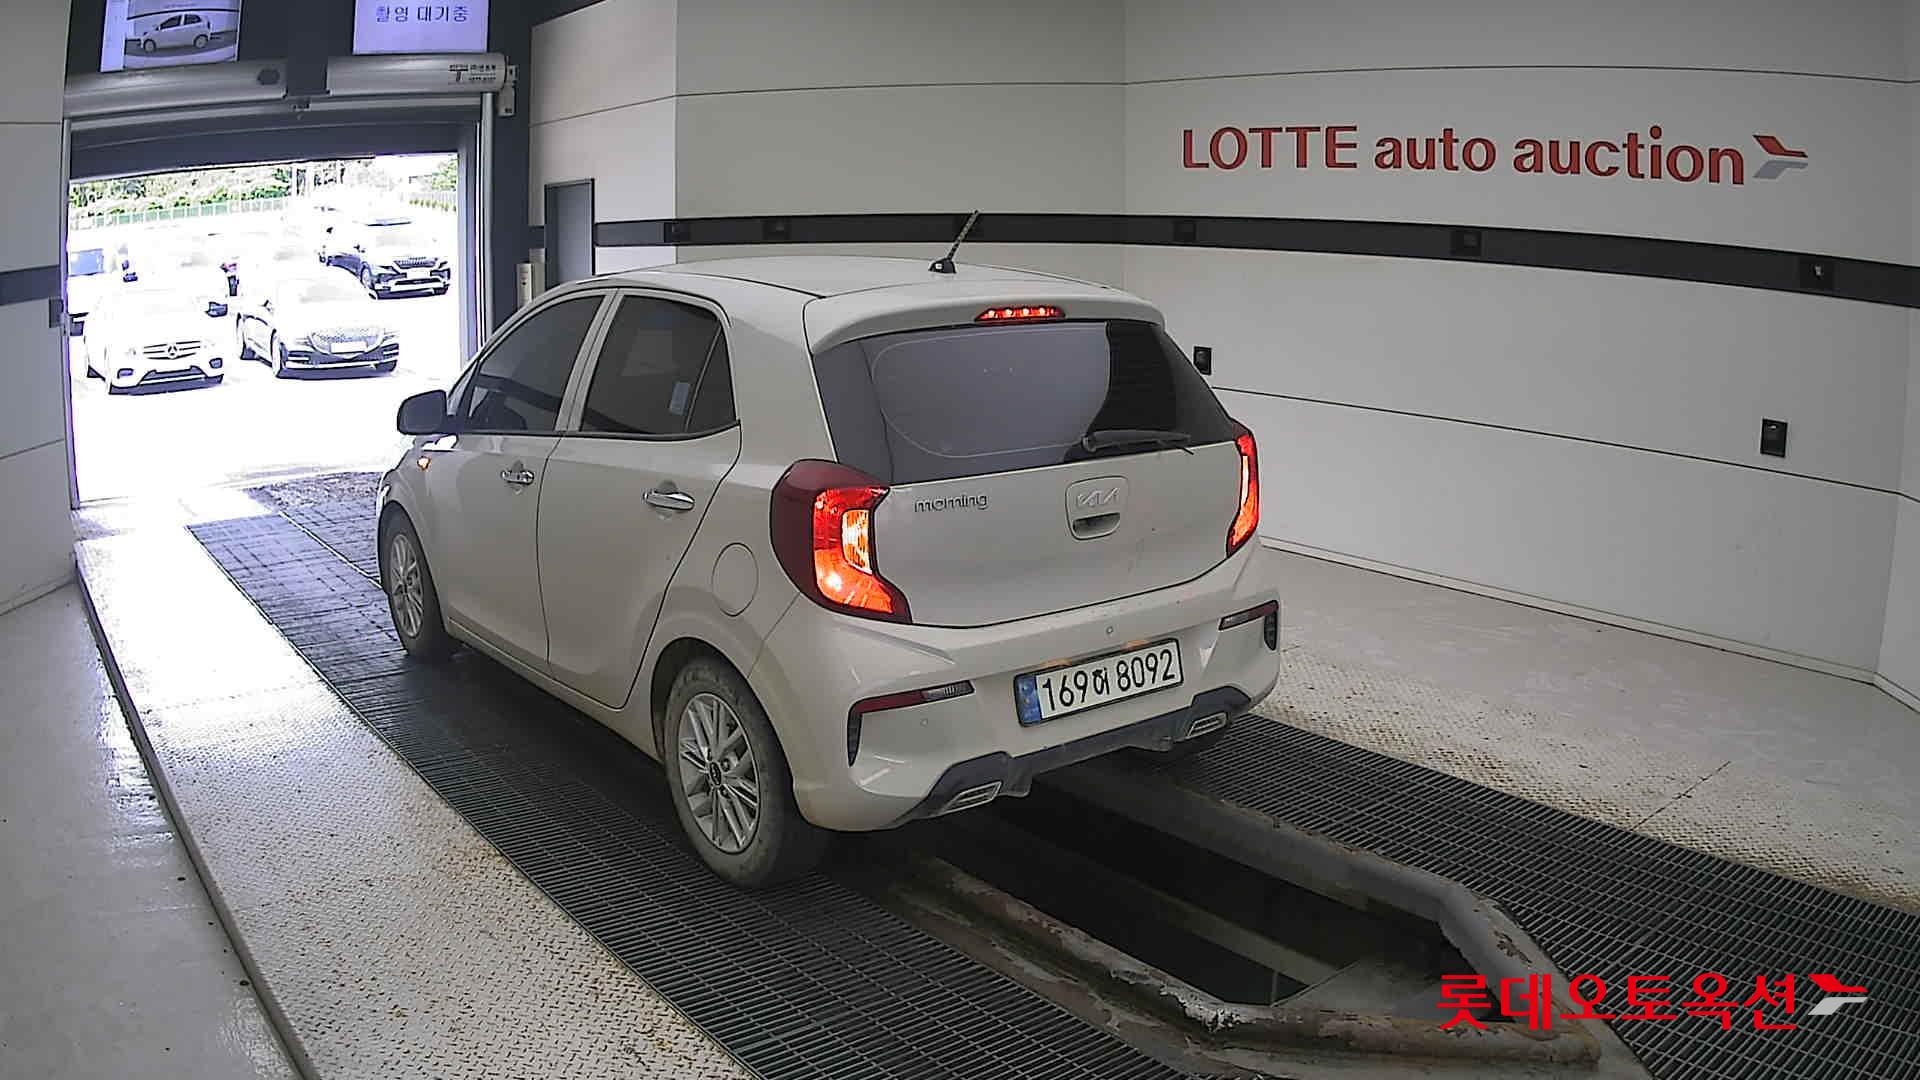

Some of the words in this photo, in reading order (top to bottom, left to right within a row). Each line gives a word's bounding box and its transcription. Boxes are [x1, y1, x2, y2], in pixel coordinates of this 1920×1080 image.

[417, 5, 470, 23] 대기중
[1182, 125, 1358, 170] LOTTE
[1374, 127, 1497, 172] auto
[1512, 124, 1746, 185] auction
[914, 493, 989, 513] morning
[1116, 649, 1175, 692] 8092
